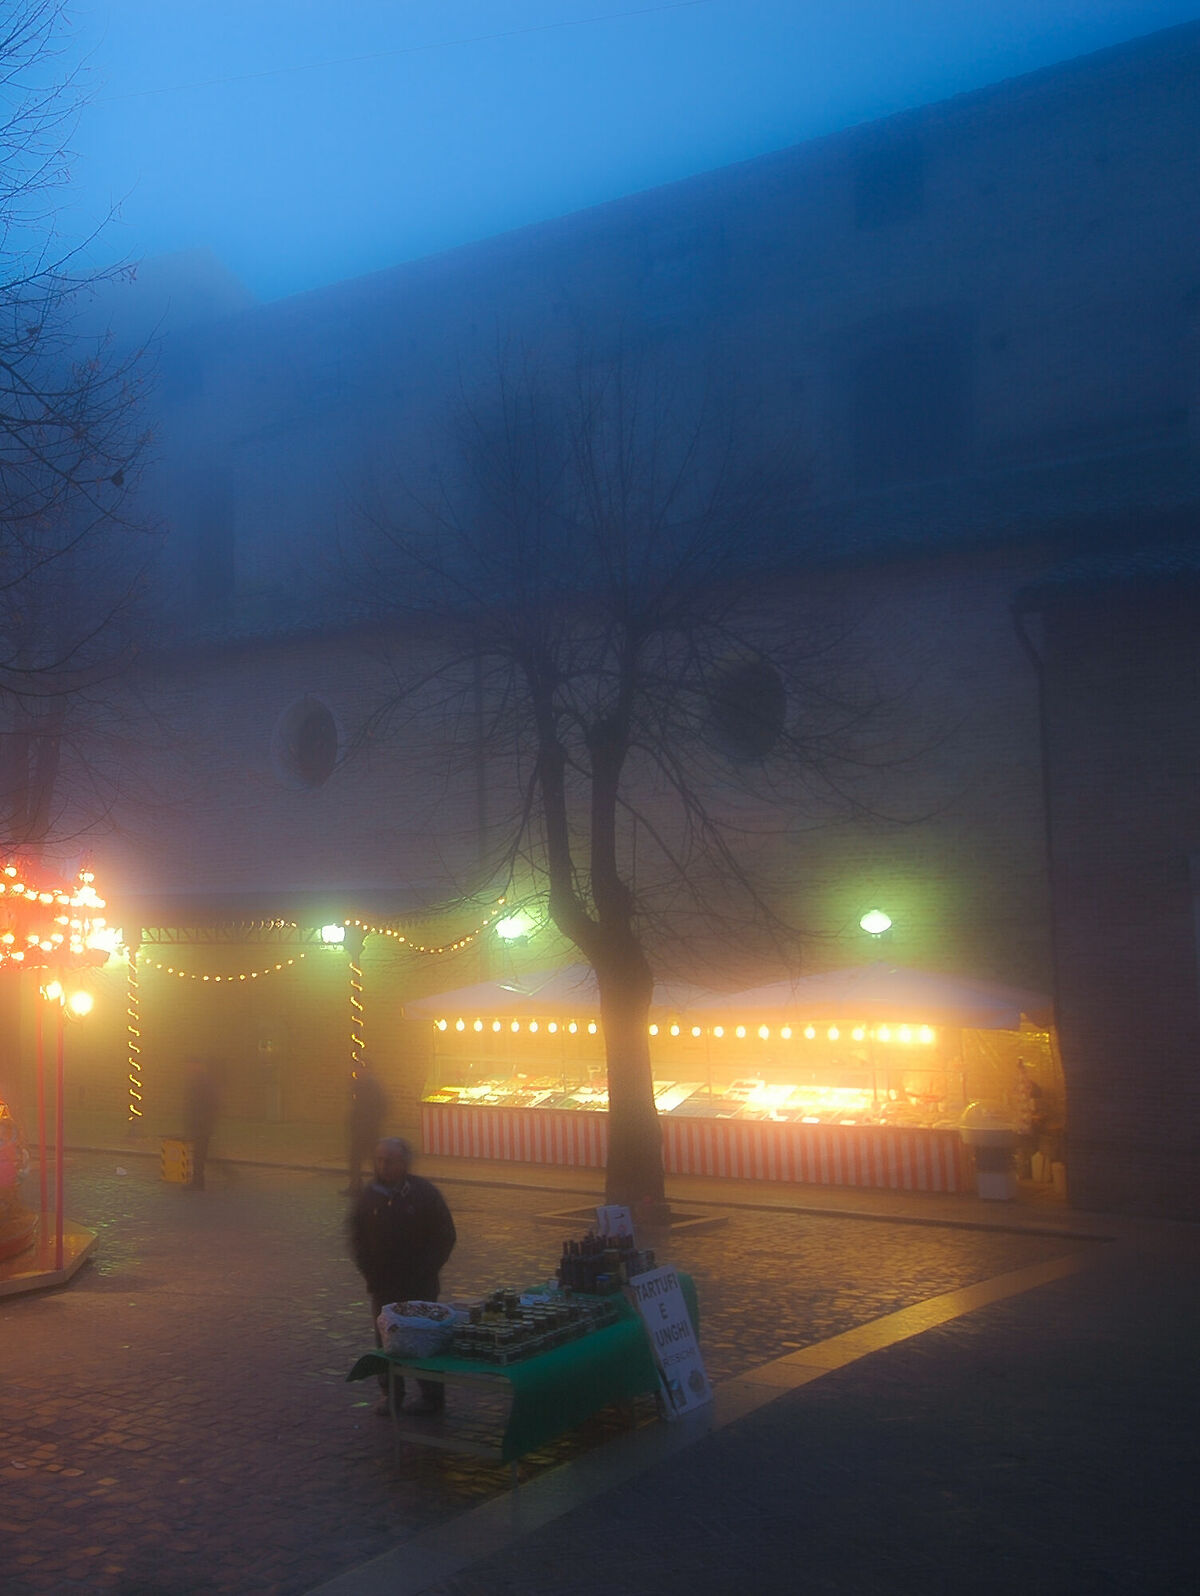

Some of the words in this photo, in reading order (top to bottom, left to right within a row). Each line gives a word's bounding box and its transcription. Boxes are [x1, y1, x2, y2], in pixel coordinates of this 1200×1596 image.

[634, 1273, 678, 1302] TARTUFI
[658, 1303, 668, 1319] E
[655, 1320, 690, 1346] UNGHI
